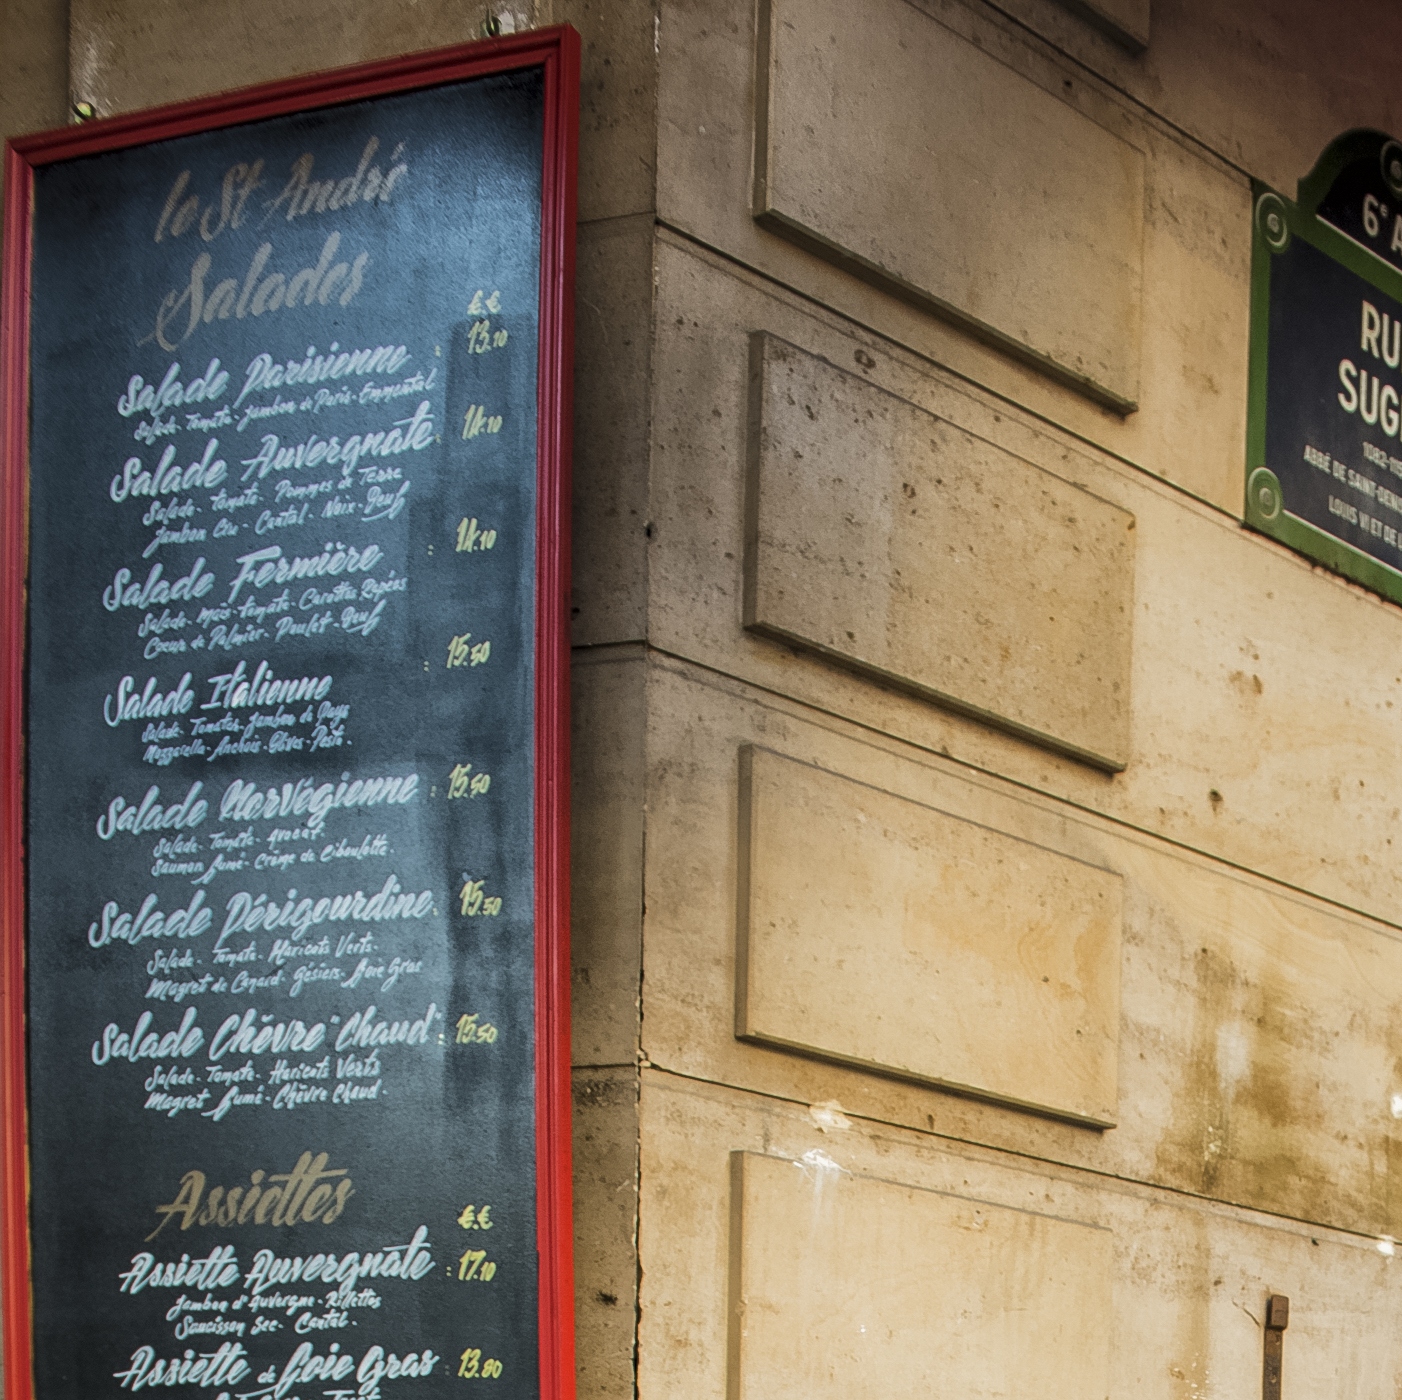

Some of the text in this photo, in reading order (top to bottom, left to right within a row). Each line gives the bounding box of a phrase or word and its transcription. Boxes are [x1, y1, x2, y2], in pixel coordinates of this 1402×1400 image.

[136, 230, 371, 351] Salades
[117, 357, 230, 417] Salade
[233, 341, 412, 409] Parisienne
[110, 437, 228, 502] Salade
[240, 400, 435, 481] Auvergnate
[102, 556, 215, 611] Salade
[228, 541, 384, 603] Fermière
[103, 632, 491, 727] Salade Italienne 15.50
[96, 763, 491, 840] Salade Norvégienne 15.50
[300, 848, 316, 862] de
[88, 874, 502, 949] Salade Périgourdine 15.50
[211, 976, 228, 993] de
[381, 956, 423, 993] Gras
[91, 1005, 205, 1066] Salade
[208, 1007, 326, 1062] Chèvre
[455, 1013, 498, 1044] 15.50
[336, 1048, 381, 1079] Verts
[144, 1150, 355, 1242] Assiettes
[118, 1224, 497, 1296] Assiette Auvergnate 17.10
[113, 1341, 251, 1392] Assiette
[257, 1364, 277, 1384] de
[356, 1345, 440, 1395] Gras
